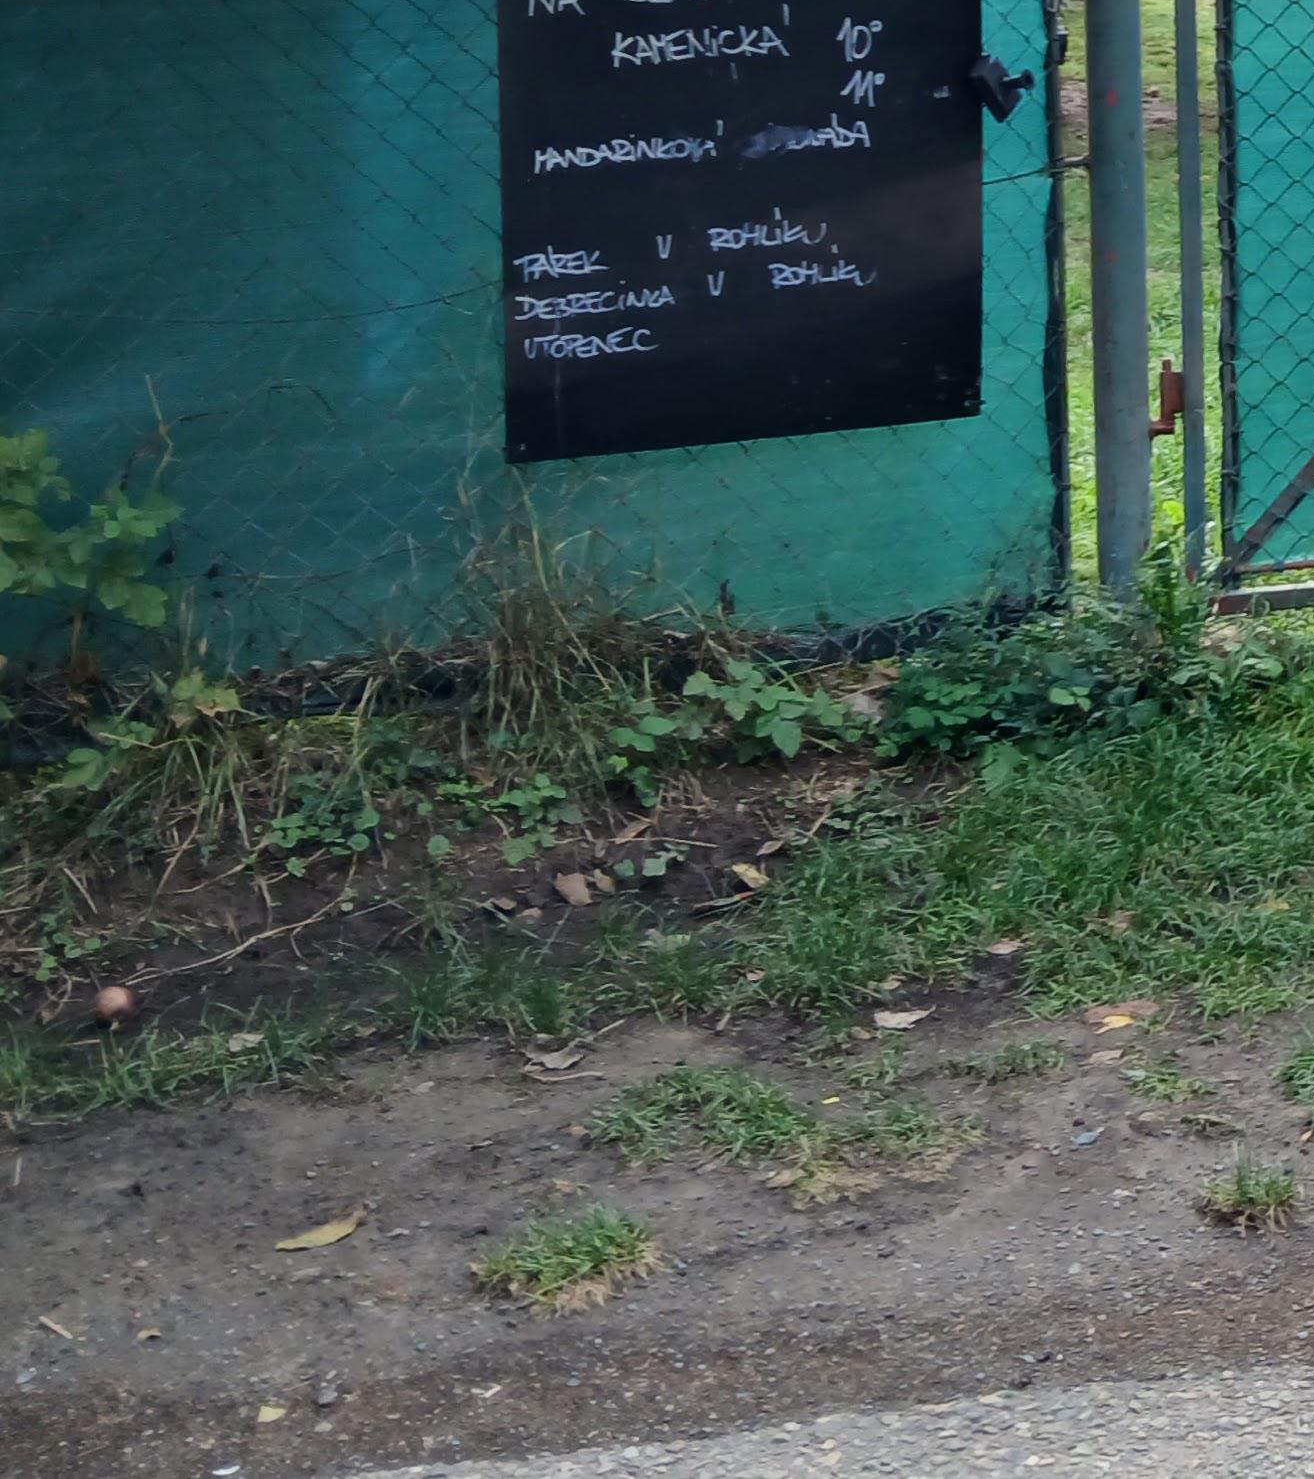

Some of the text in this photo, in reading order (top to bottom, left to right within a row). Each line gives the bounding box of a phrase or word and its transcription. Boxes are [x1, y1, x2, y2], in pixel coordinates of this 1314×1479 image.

[656, 234, 673, 259] V
[707, 270, 726, 297] V
[523, 326, 662, 361] UTOPENEC
